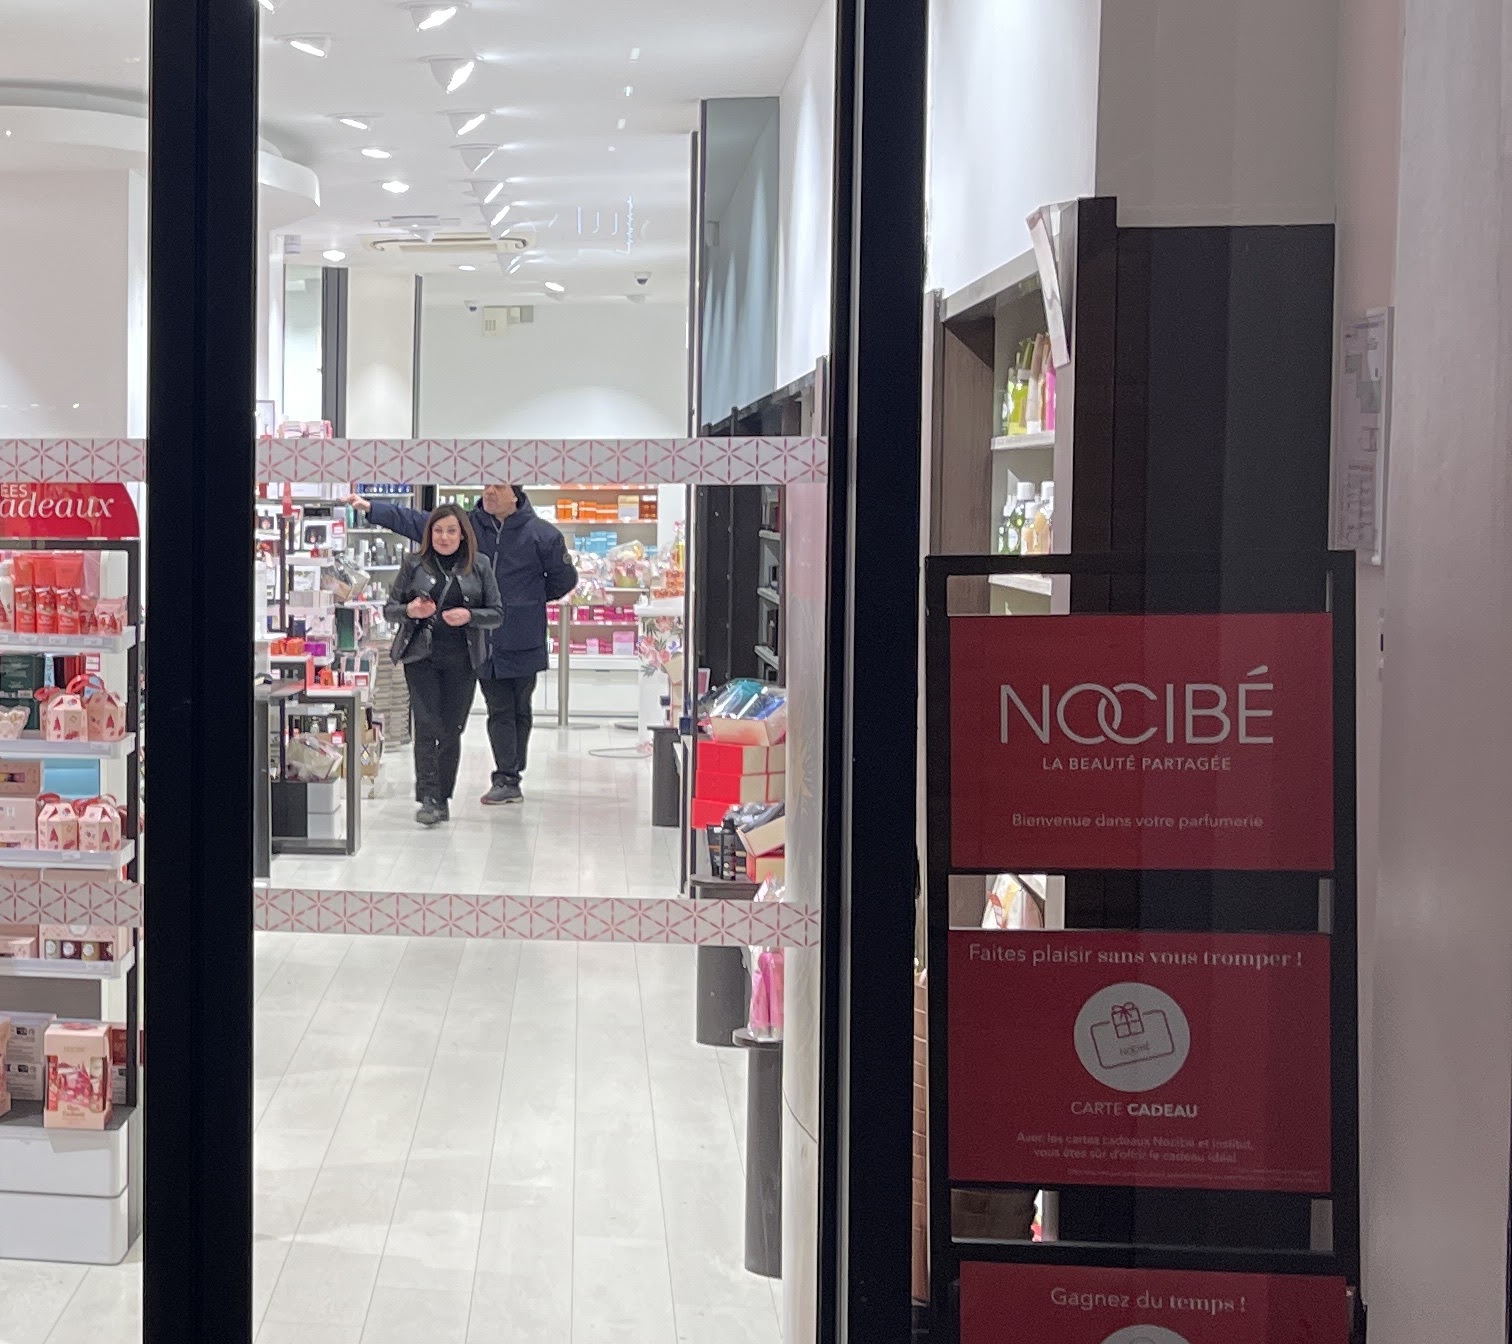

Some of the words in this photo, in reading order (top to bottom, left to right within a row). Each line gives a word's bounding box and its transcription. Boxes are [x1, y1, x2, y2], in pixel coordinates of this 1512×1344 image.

[1000, 665, 1274, 745] NOCIBÉ
[1042, 757, 1063, 771] LA
[1069, 755, 1135, 771] BEAUTÉ
[1142, 755, 1231, 771] PARTAGÉE
[1012, 813, 1091, 827] Bienvenue
[1095, 814, 1132, 827] dans
[1136, 816, 1175, 827] votre
[1179, 813, 1263, 830] parfumerie
[969, 943, 1026, 962] Faites
[1033, 944, 1092, 966] plaisir
[1097, 950, 1144, 964] sans
[1150, 952, 1198, 966] vous
[1203, 951, 1291, 970] tromper
[1070, 1101, 1122, 1116] CARTE
[1127, 1104, 1198, 1118] CADEAU
[1050, 1287, 1130, 1311] Gagnez
[1136, 1290, 1163, 1309] du
[1169, 1295, 1235, 1316] temps
